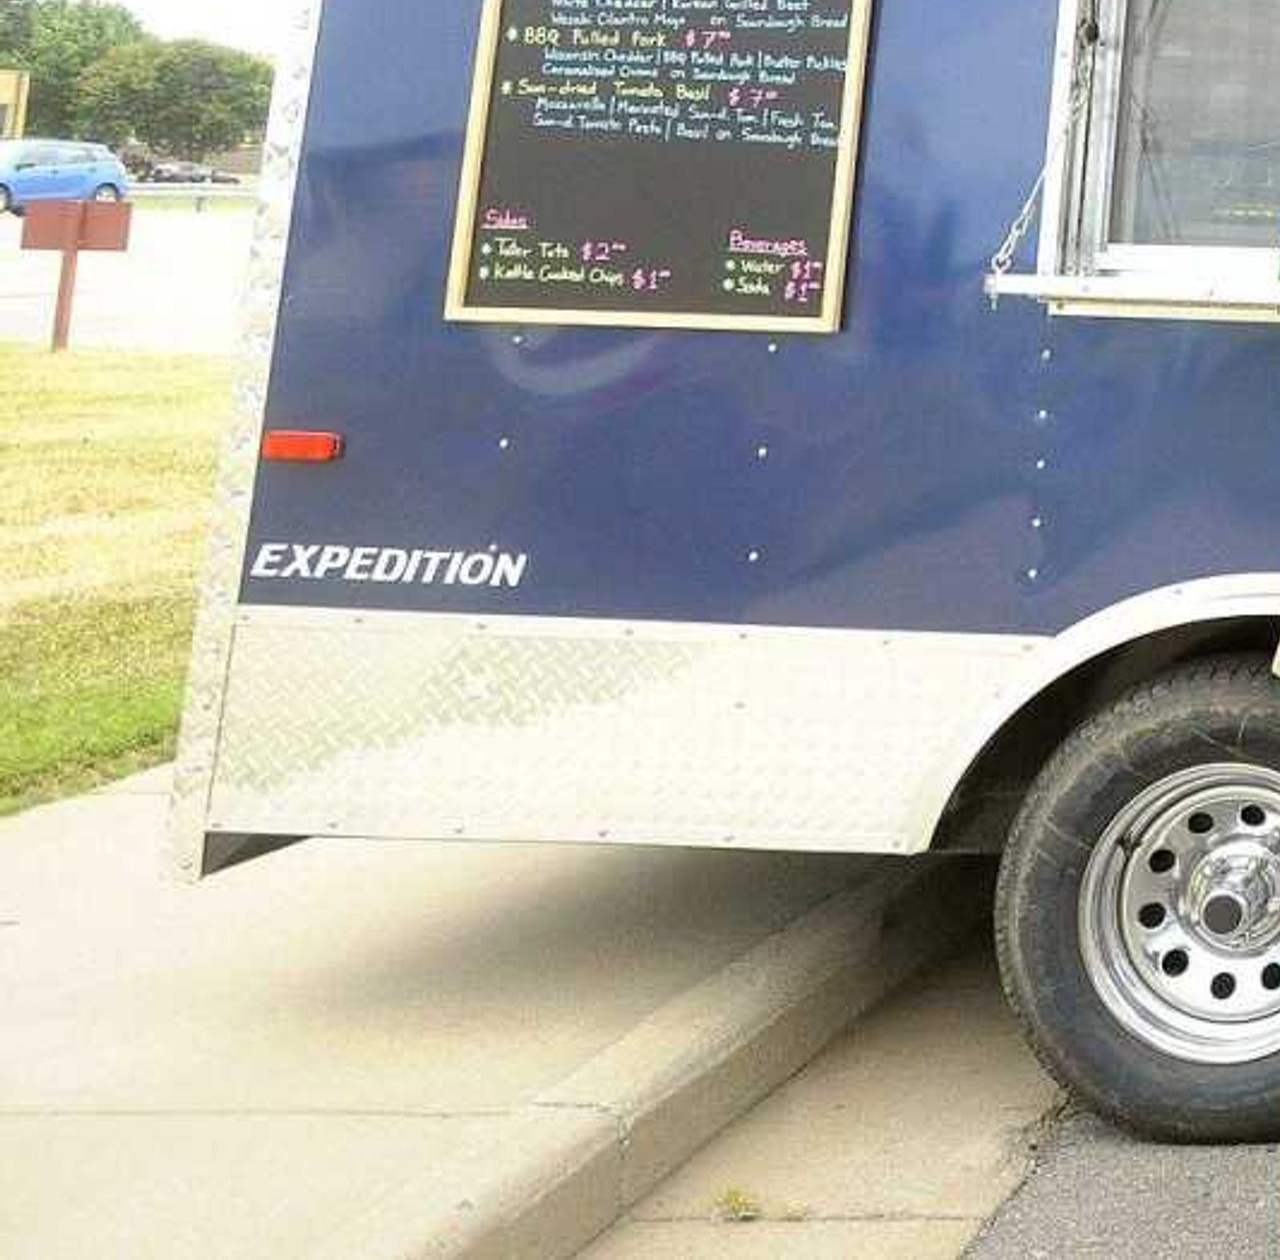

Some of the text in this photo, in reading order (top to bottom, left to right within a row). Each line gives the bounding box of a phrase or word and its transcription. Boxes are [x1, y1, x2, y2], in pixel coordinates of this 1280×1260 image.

[524, 26, 560, 46] BBQ
[573, 27, 621, 46] Pulled
[630, 30, 667, 47] Pork
[675, 84, 713, 101] Basil
[589, 267, 625, 287] Chips
[250, 542, 527, 587] EXPEDITION
